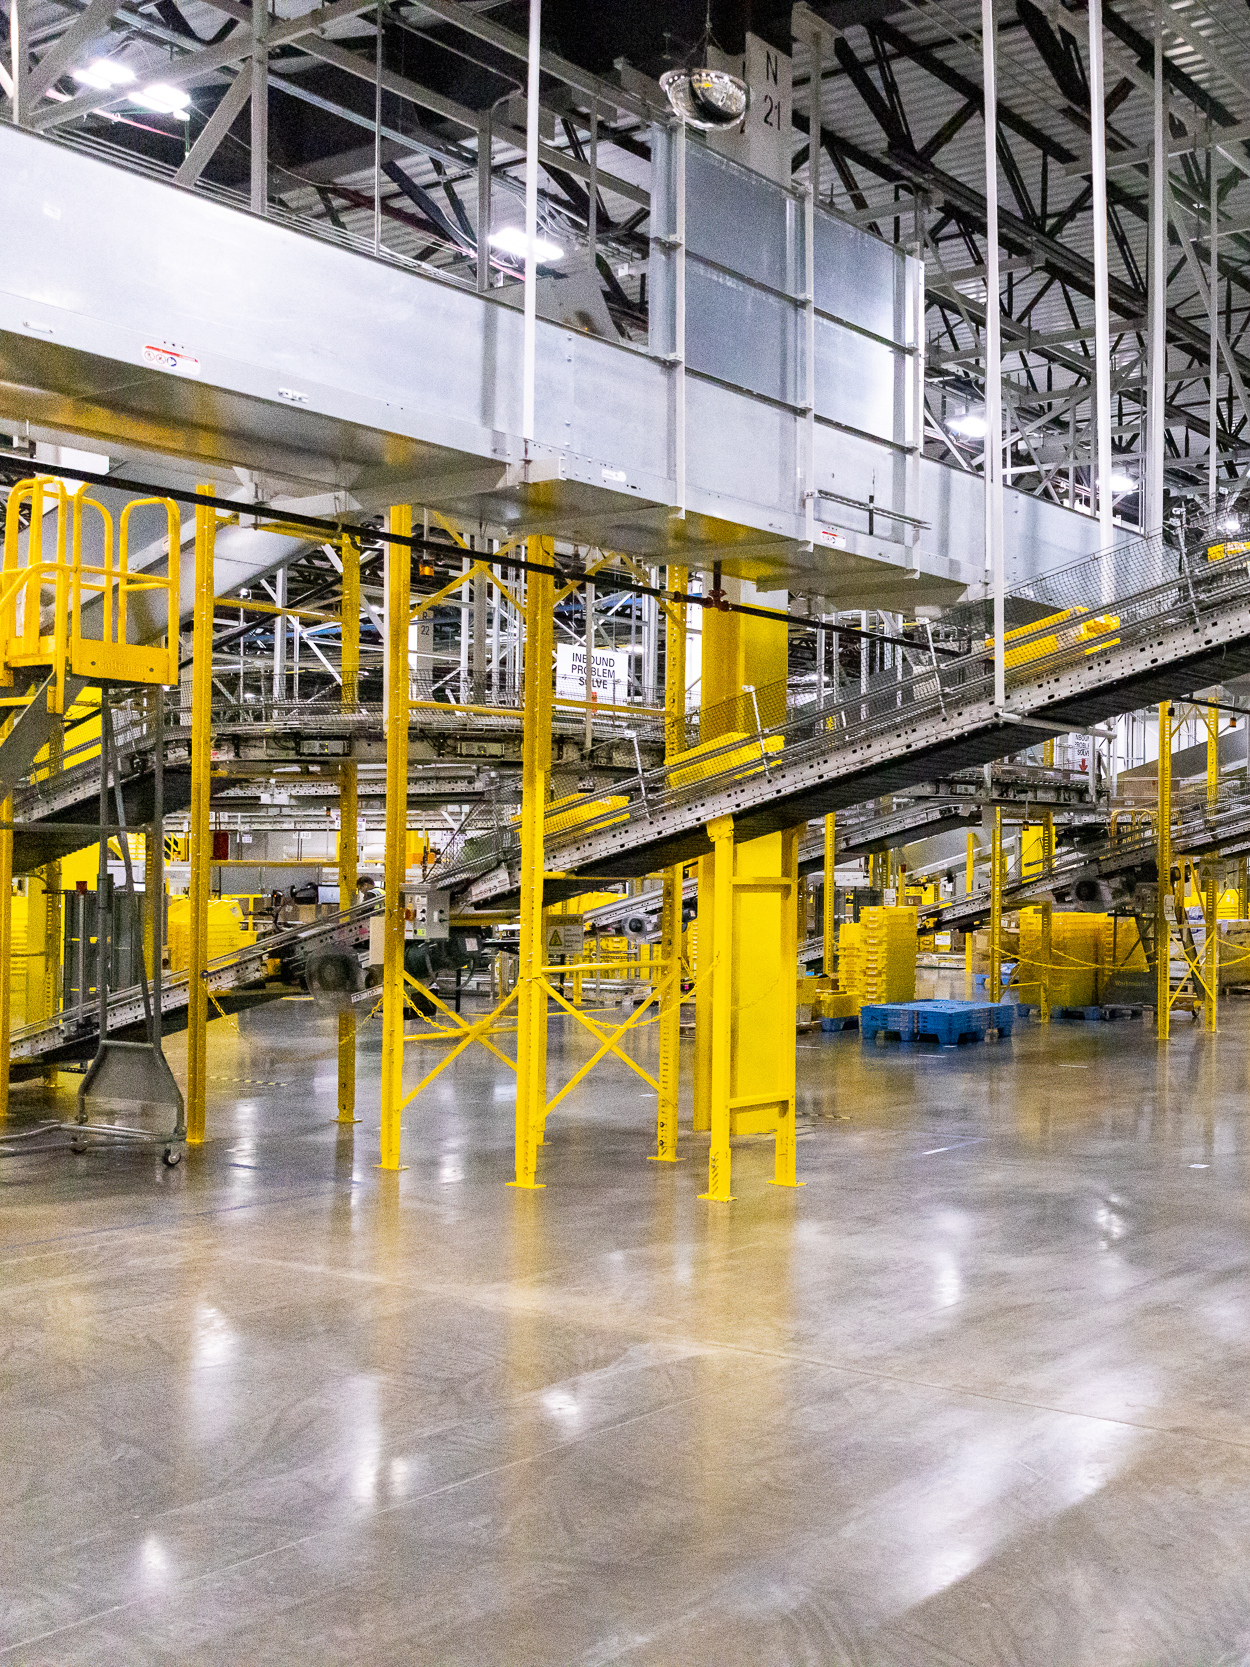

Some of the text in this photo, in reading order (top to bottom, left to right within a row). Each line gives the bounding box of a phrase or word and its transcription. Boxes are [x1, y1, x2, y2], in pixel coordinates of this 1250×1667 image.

[766, 50, 778, 86] N
[763, 94, 781, 131] 21
[421, 625, 430, 636] 22
[578, 676, 608, 690] SLVE
